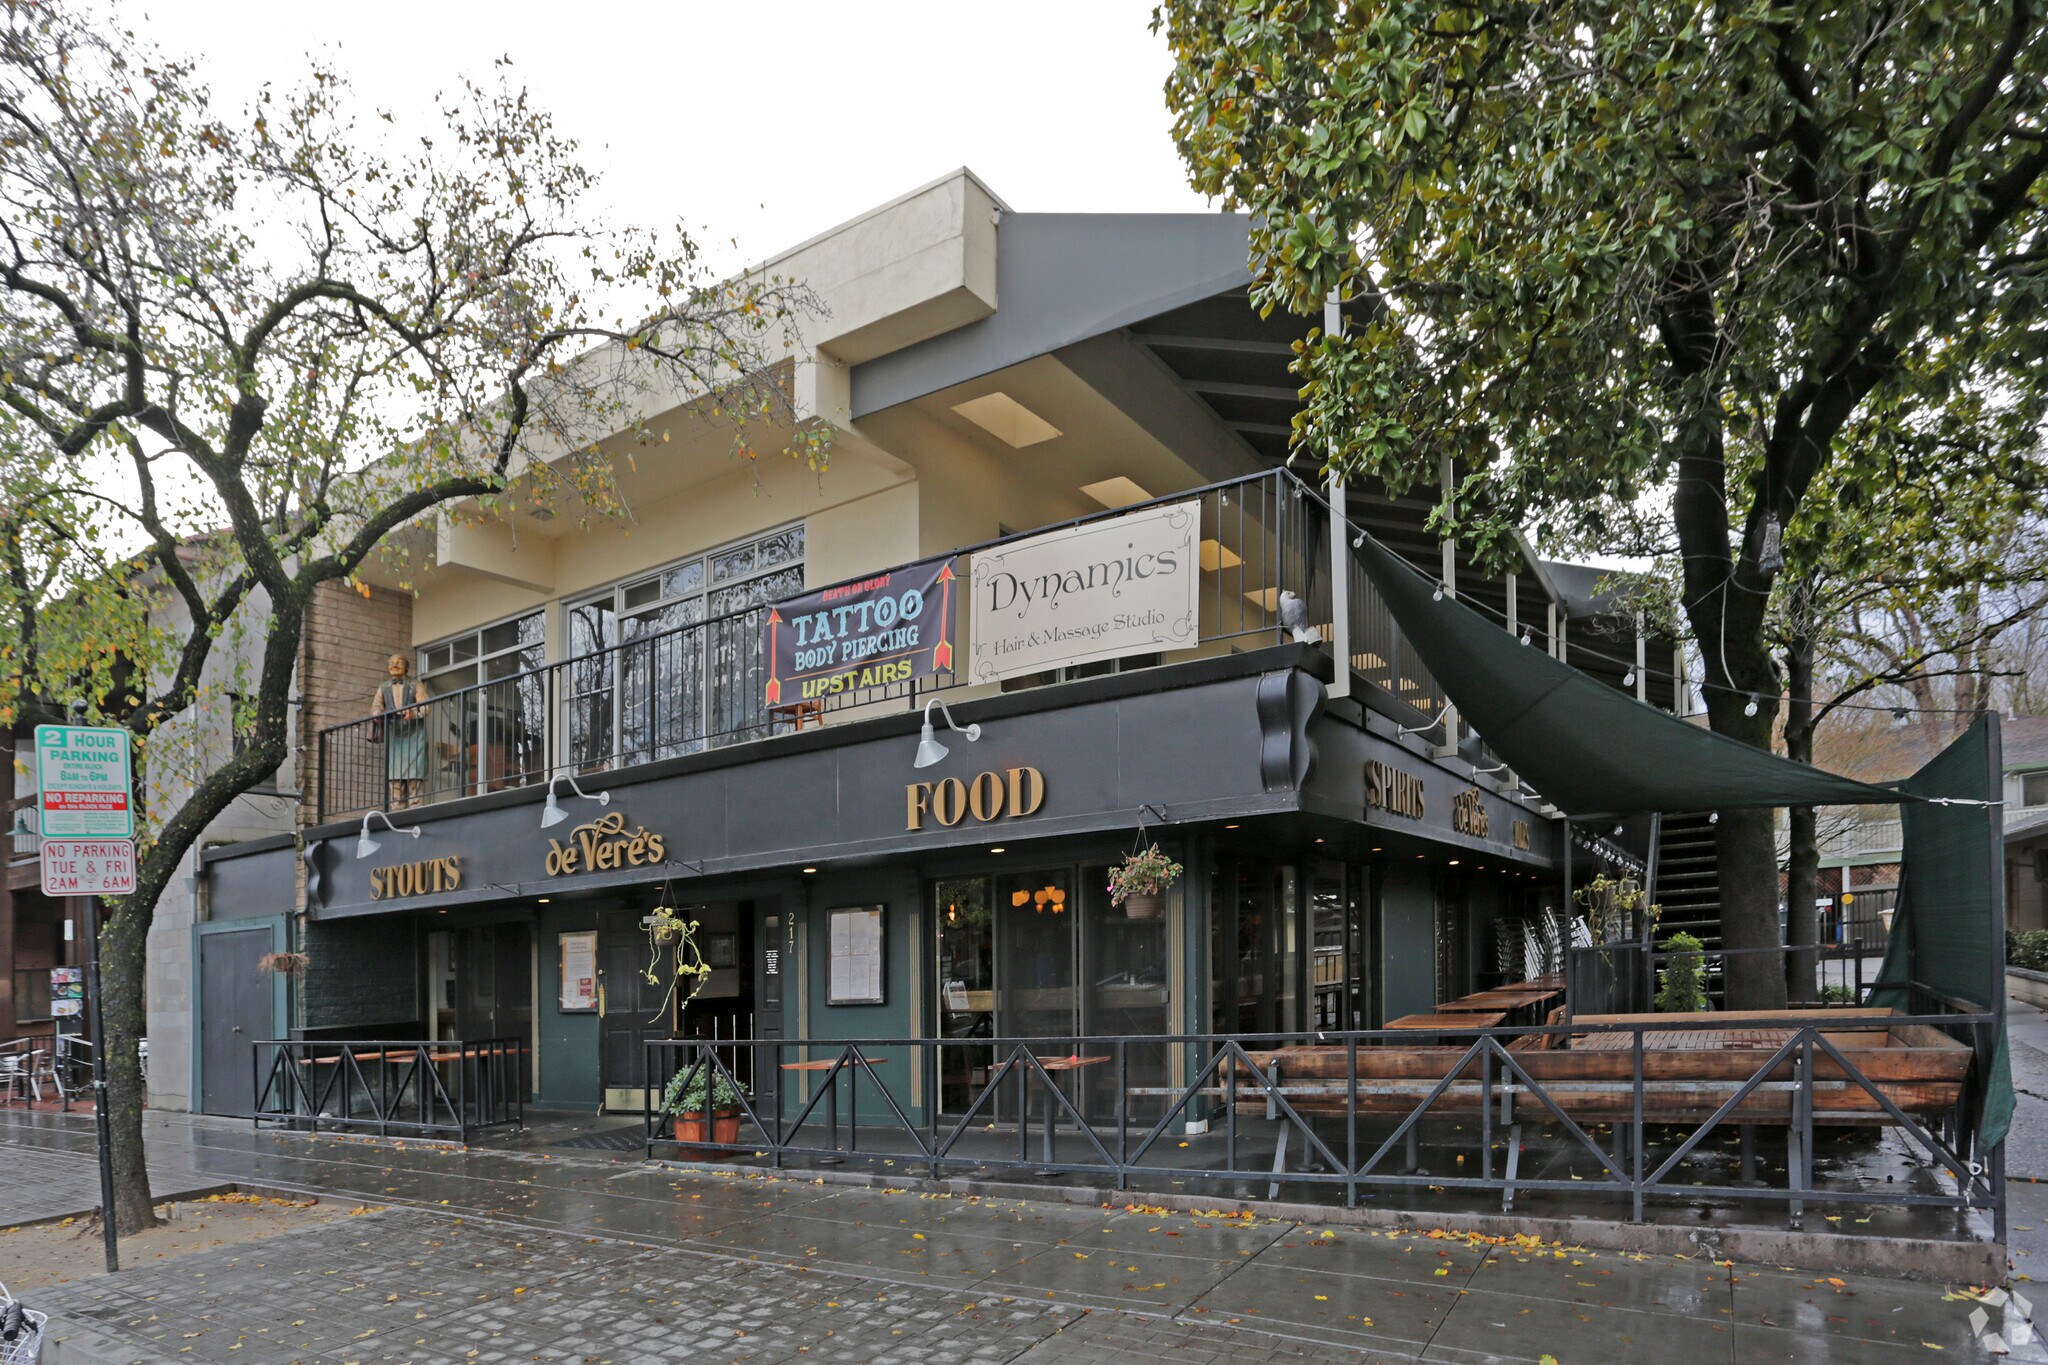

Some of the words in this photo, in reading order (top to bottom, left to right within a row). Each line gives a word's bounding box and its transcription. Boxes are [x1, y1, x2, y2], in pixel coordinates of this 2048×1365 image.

[822, 585, 850, 601] DEATH
[852, 582, 863, 595] OR
[864, 575, 890, 592] GLORY
[986, 542, 1177, 619] Dynamics
[792, 588, 923, 646] TATTOO
[993, 636, 1024, 656] Hair
[1027, 632, 1040, 647] &
[1043, 622, 1109, 645] Massage
[1113, 609, 1165, 631] Studio
[677, 642, 736, 674] SPIITS
[794, 640, 837, 671] BODY
[841, 625, 919, 661] PIERCING
[802, 659, 912, 698] UPSTAIRS
[44, 730, 61, 745] 2
[75, 735, 115, 748] HOUR
[50, 750, 119, 762] PARKING
[60, 771, 79, 780] 8AM
[89, 771, 108, 781] 6PM
[1366, 760, 1425, 820] SPIRITS
[46, 793, 62, 802] NO
[64, 793, 125, 803] REPARKING
[905, 766, 1045, 831] FOOD
[48, 845, 65, 858] NO
[73, 844, 129, 857] PARKING
[51, 861, 77, 874] TUE
[86, 860, 96, 873] &
[106, 860, 127, 873] FRI
[50, 876, 78, 889] 2AM
[103, 876, 130, 889] 6AM
[369, 856, 461, 900] STOUTS
